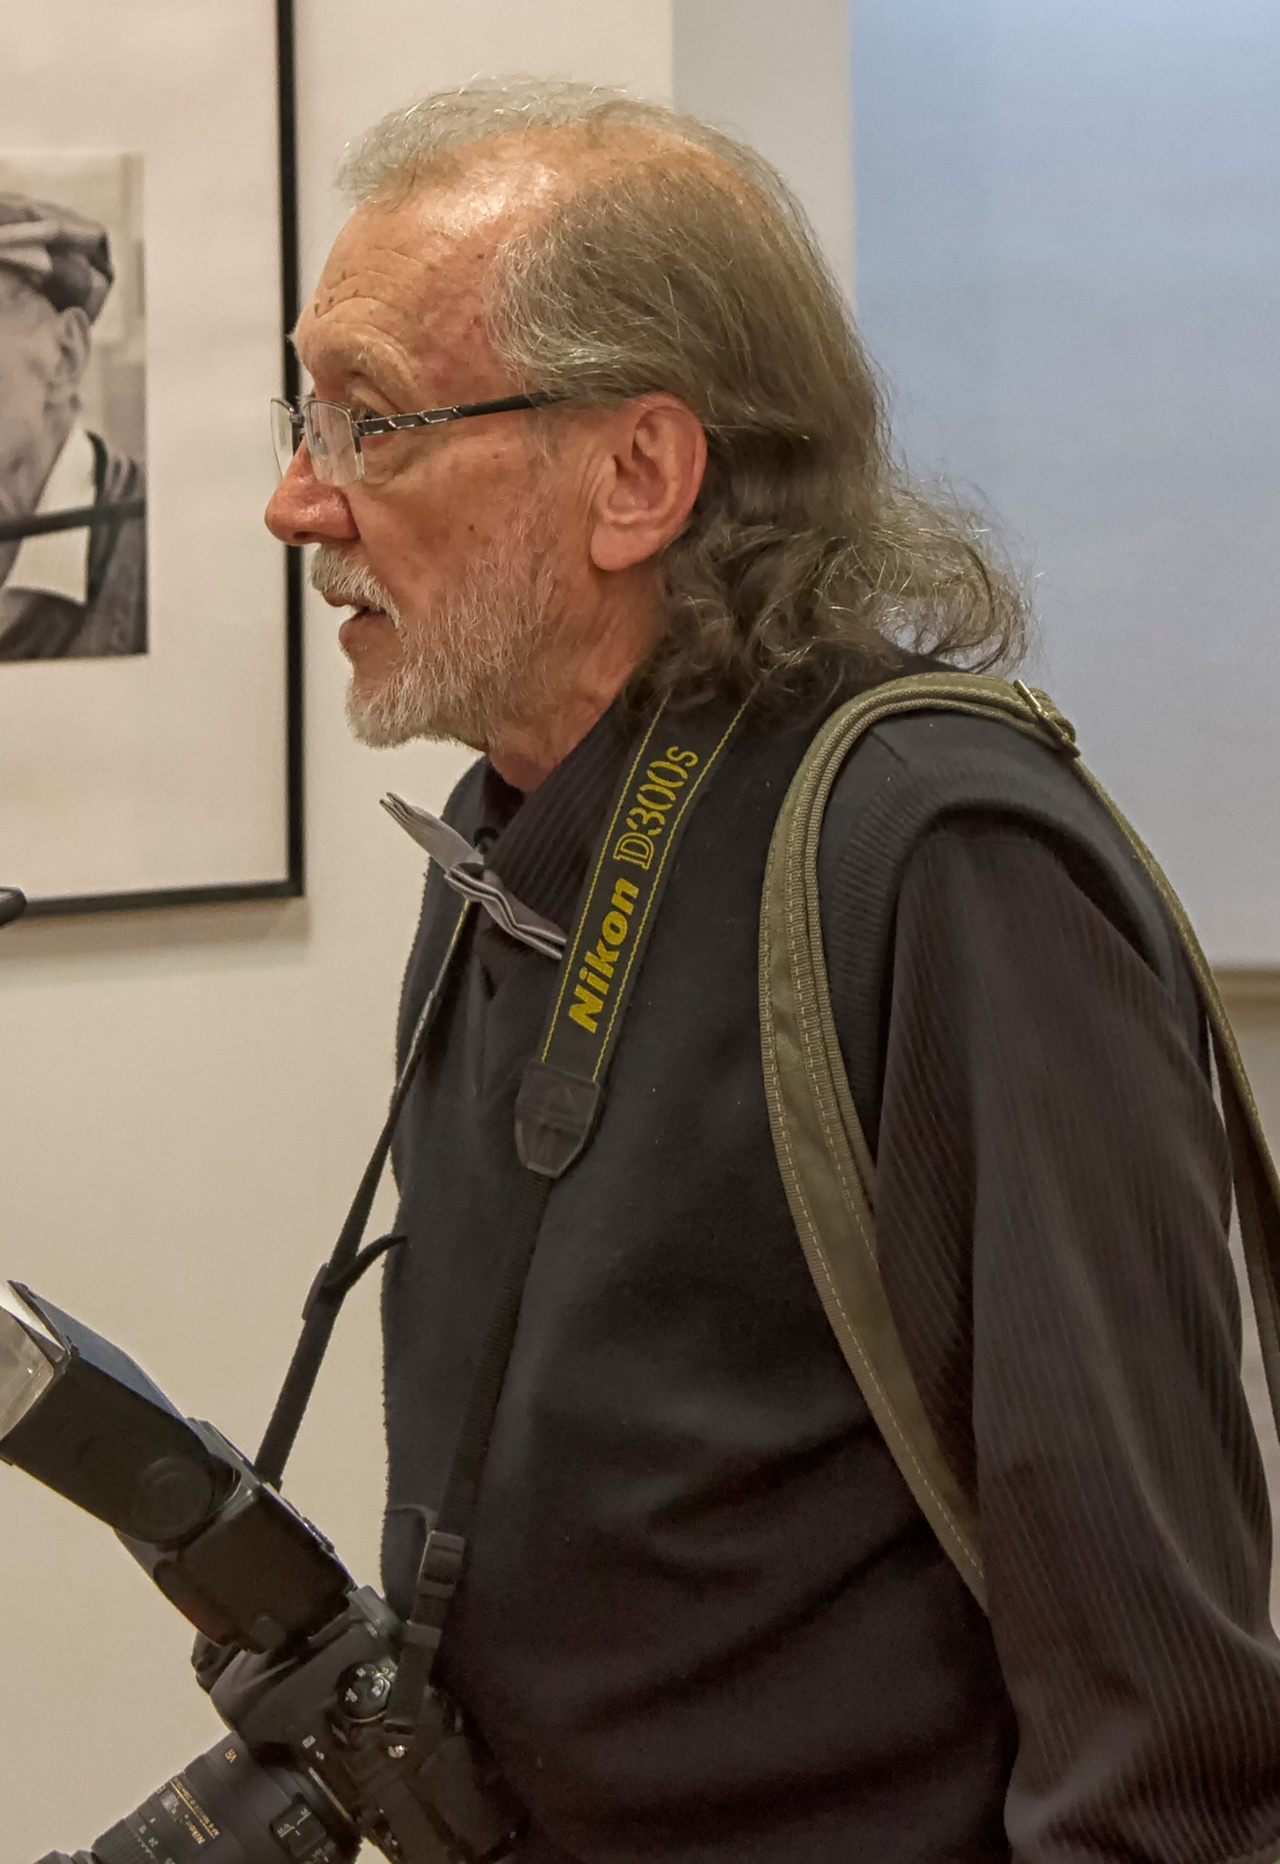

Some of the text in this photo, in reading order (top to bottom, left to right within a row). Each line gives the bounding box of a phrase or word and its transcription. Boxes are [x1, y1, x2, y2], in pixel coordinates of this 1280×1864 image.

[567, 745, 699, 1034] Nikon D300s
[224, 1748, 238, 1763] VR
[185, 1820, 206, 1845] Nikon
